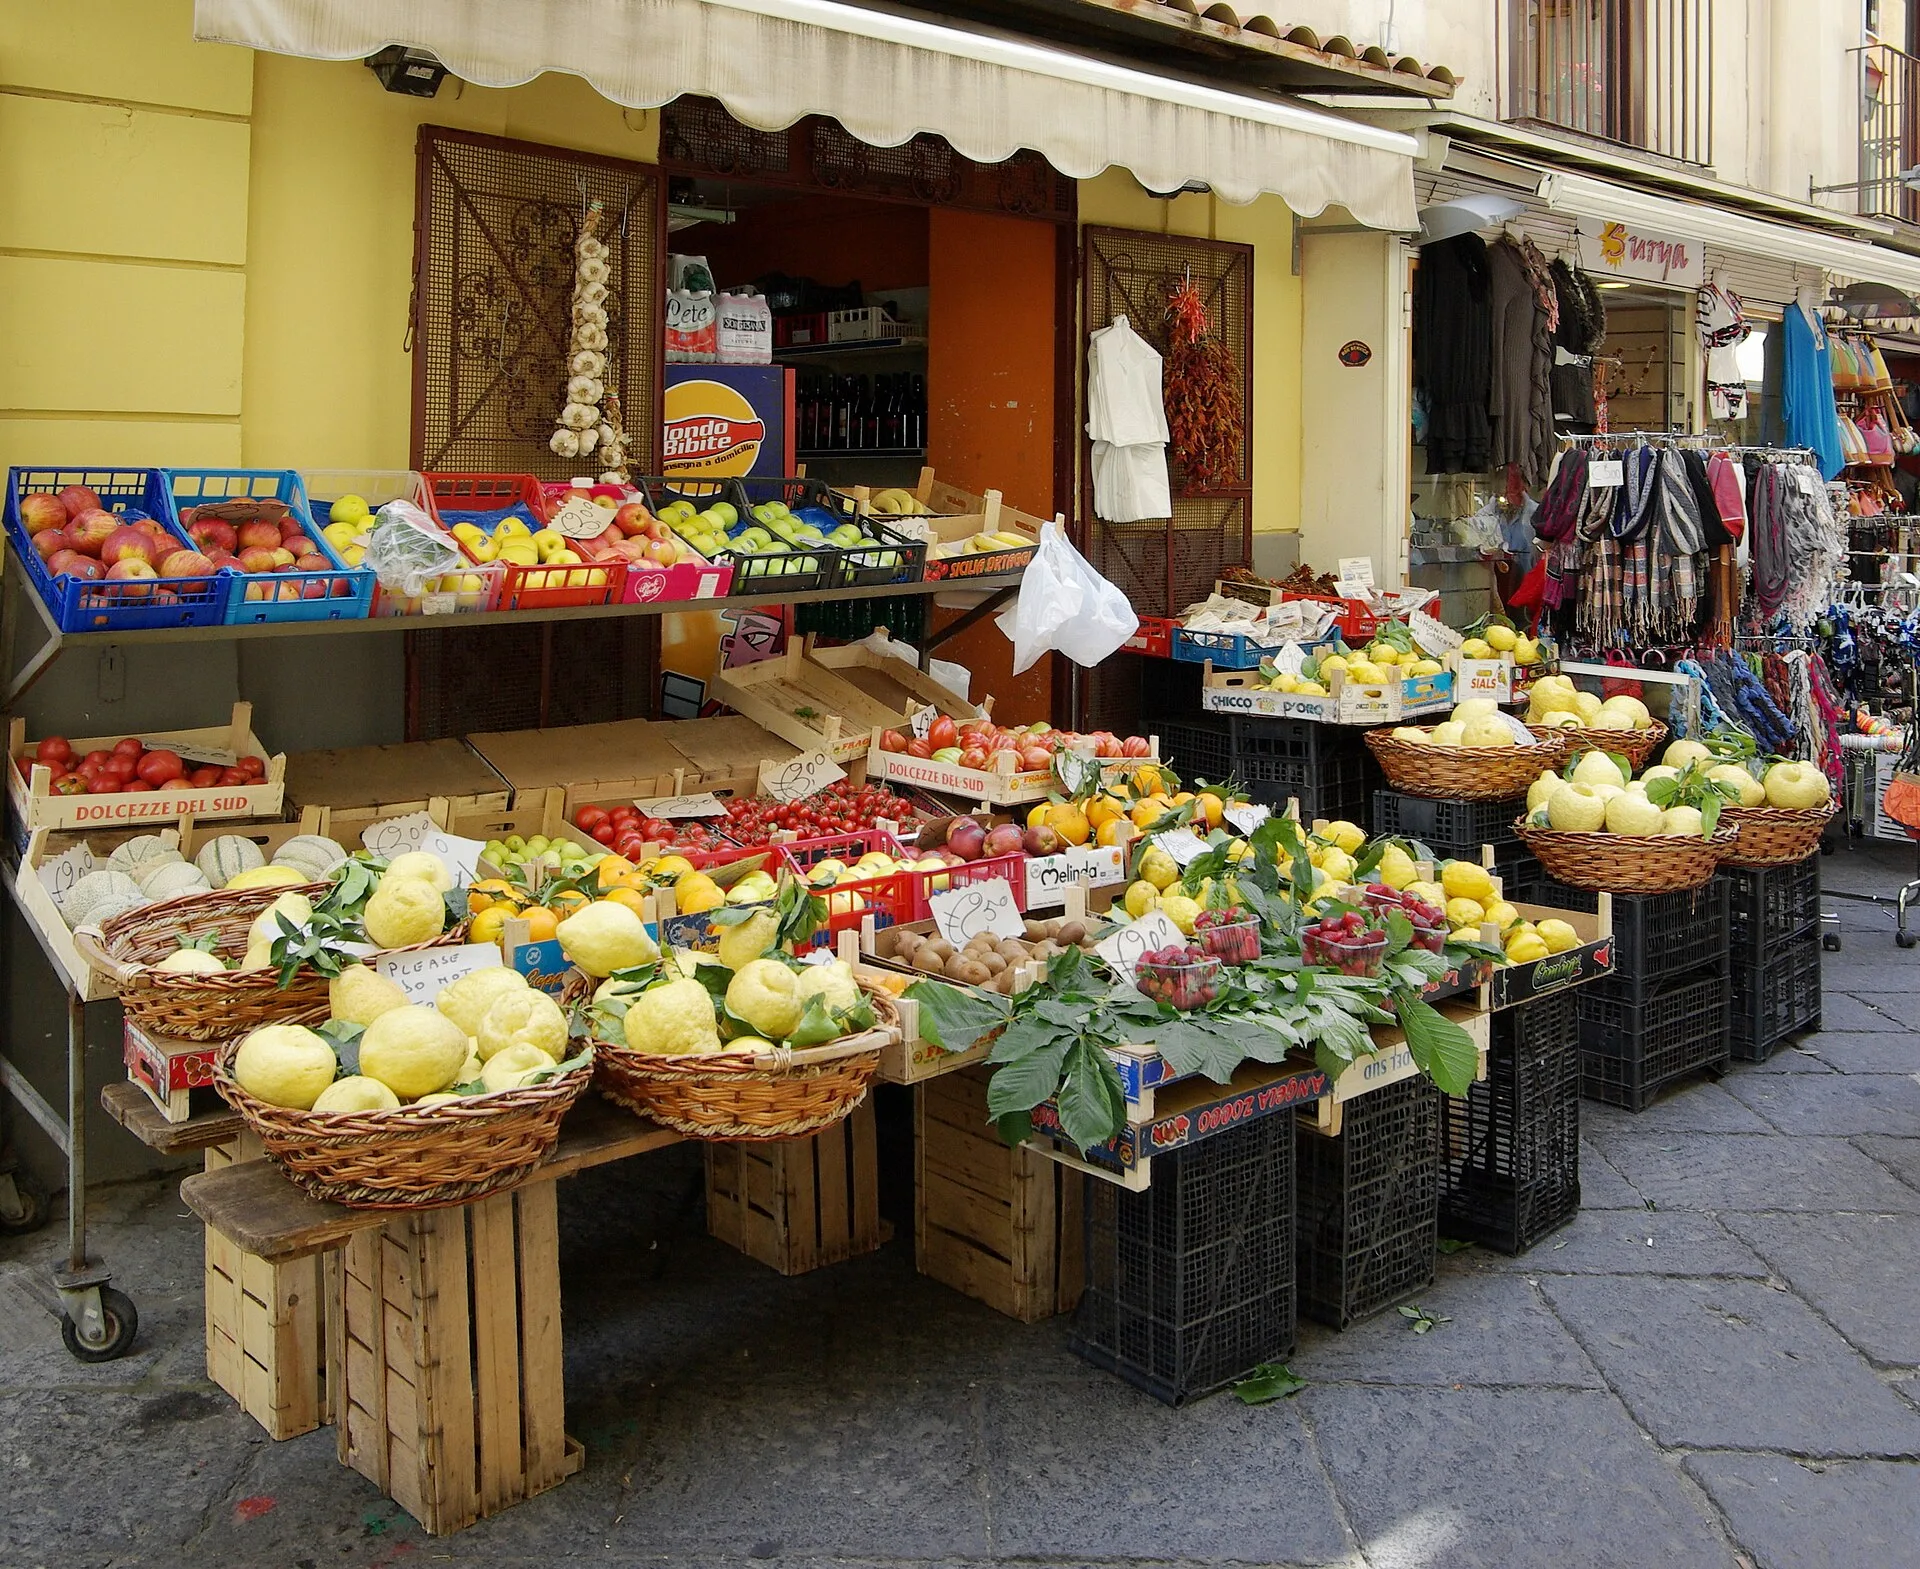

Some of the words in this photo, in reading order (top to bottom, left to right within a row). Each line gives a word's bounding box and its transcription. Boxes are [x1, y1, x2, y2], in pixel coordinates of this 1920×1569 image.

[1607, 223, 1689, 281] Surya
[664, 436, 732, 456] Bibite
[714, 442, 755, 464] domicilio
[950, 558, 986, 578] SICILIA
[1471, 678, 1497, 690] SIALS
[1211, 695, 1252, 709] CHICCO
[1284, 701, 1324, 716] D'ORO
[889, 763, 939, 784] DOLCEZZE
[942, 773, 961, 788] DEL
[963, 778, 984, 792] SUD
[76, 801, 171, 821] DOLCEZZE
[176, 800, 207, 815] DEL
[212, 797, 248, 812] SUD
[1041, 861, 1097, 886] Melinda
[388, 953, 460, 978] PLEASE
[438, 967, 473, 984] NOT
[1364, 1059, 1387, 1080] SUD
[1391, 1050, 1411, 1071] DEL
[1258, 1073, 1325, 1111] ANGELA
